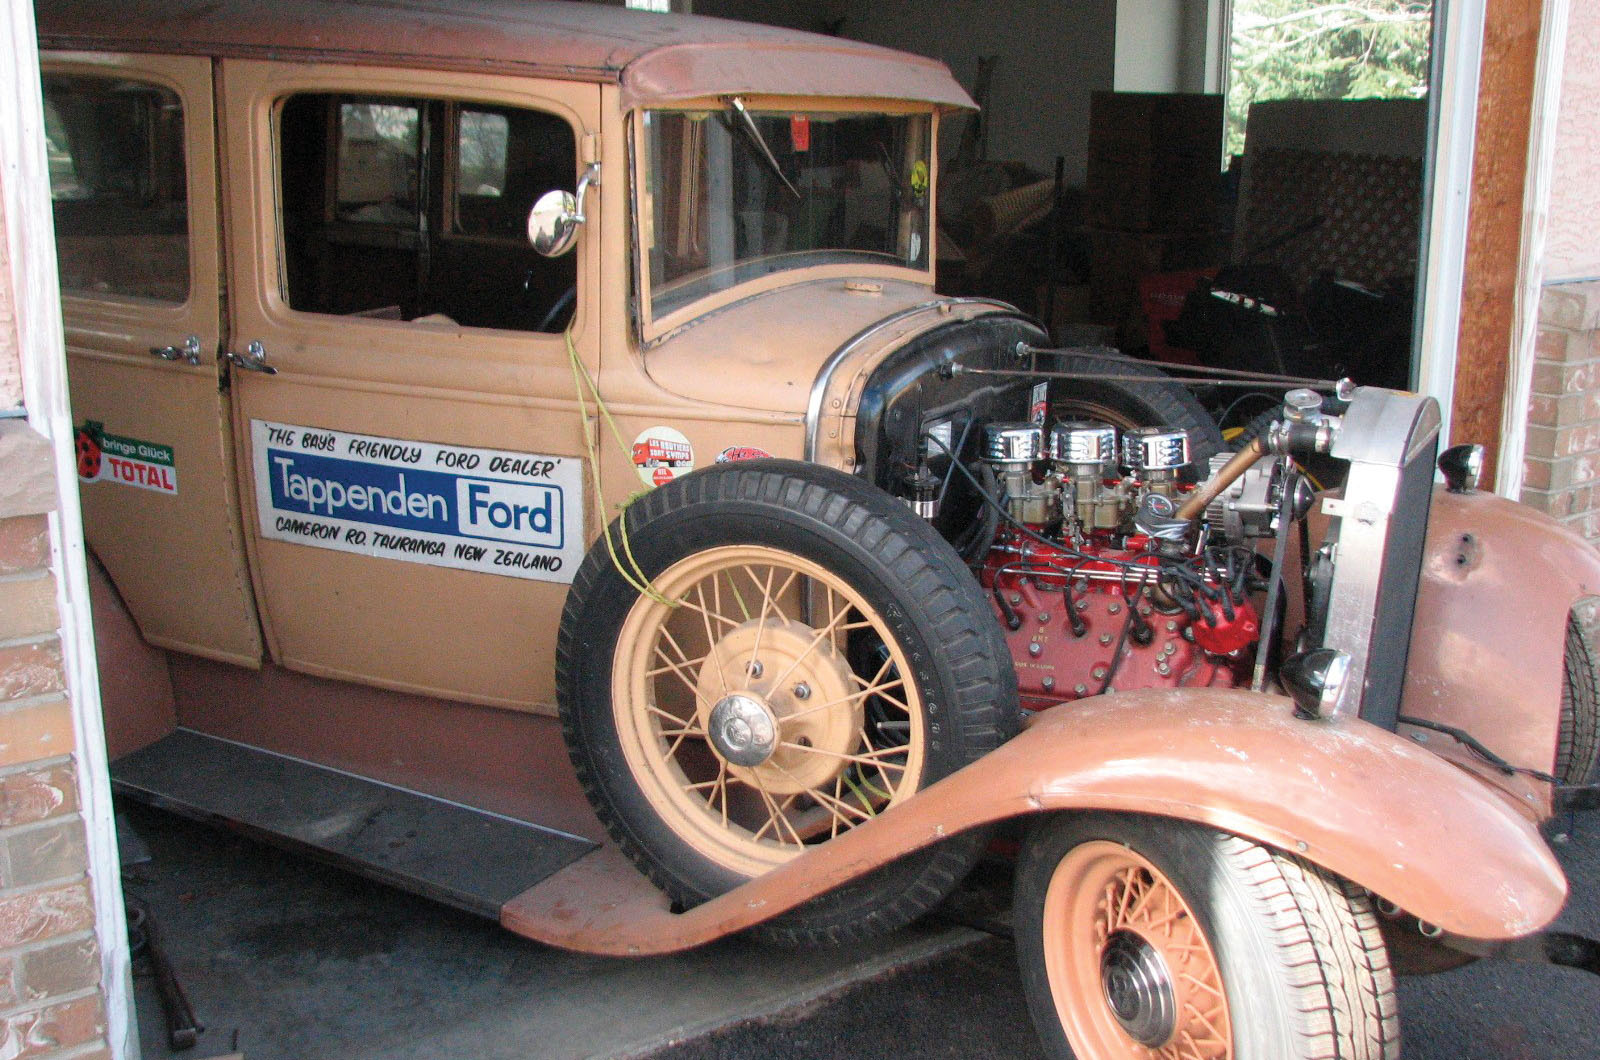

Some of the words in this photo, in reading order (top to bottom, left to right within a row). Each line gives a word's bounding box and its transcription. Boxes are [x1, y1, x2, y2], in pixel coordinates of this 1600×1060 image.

[103, 438, 136, 455] bringe
[138, 445, 170, 461] Glück
[302, 432, 336, 451] BAY'S
[349, 439, 421, 464] FRIENDLY
[436, 450, 480, 470] FORD
[108, 457, 174, 491] TOTAL
[274, 456, 448, 522] Tappenden
[469, 484, 552, 534] Ford
[276, 516, 341, 540] CAMERON
[345, 528, 366, 546] RD.
[373, 532, 446, 557] TAURANGA
[454, 543, 487, 562] NEW
[494, 549, 562, 572] ZEALAND
